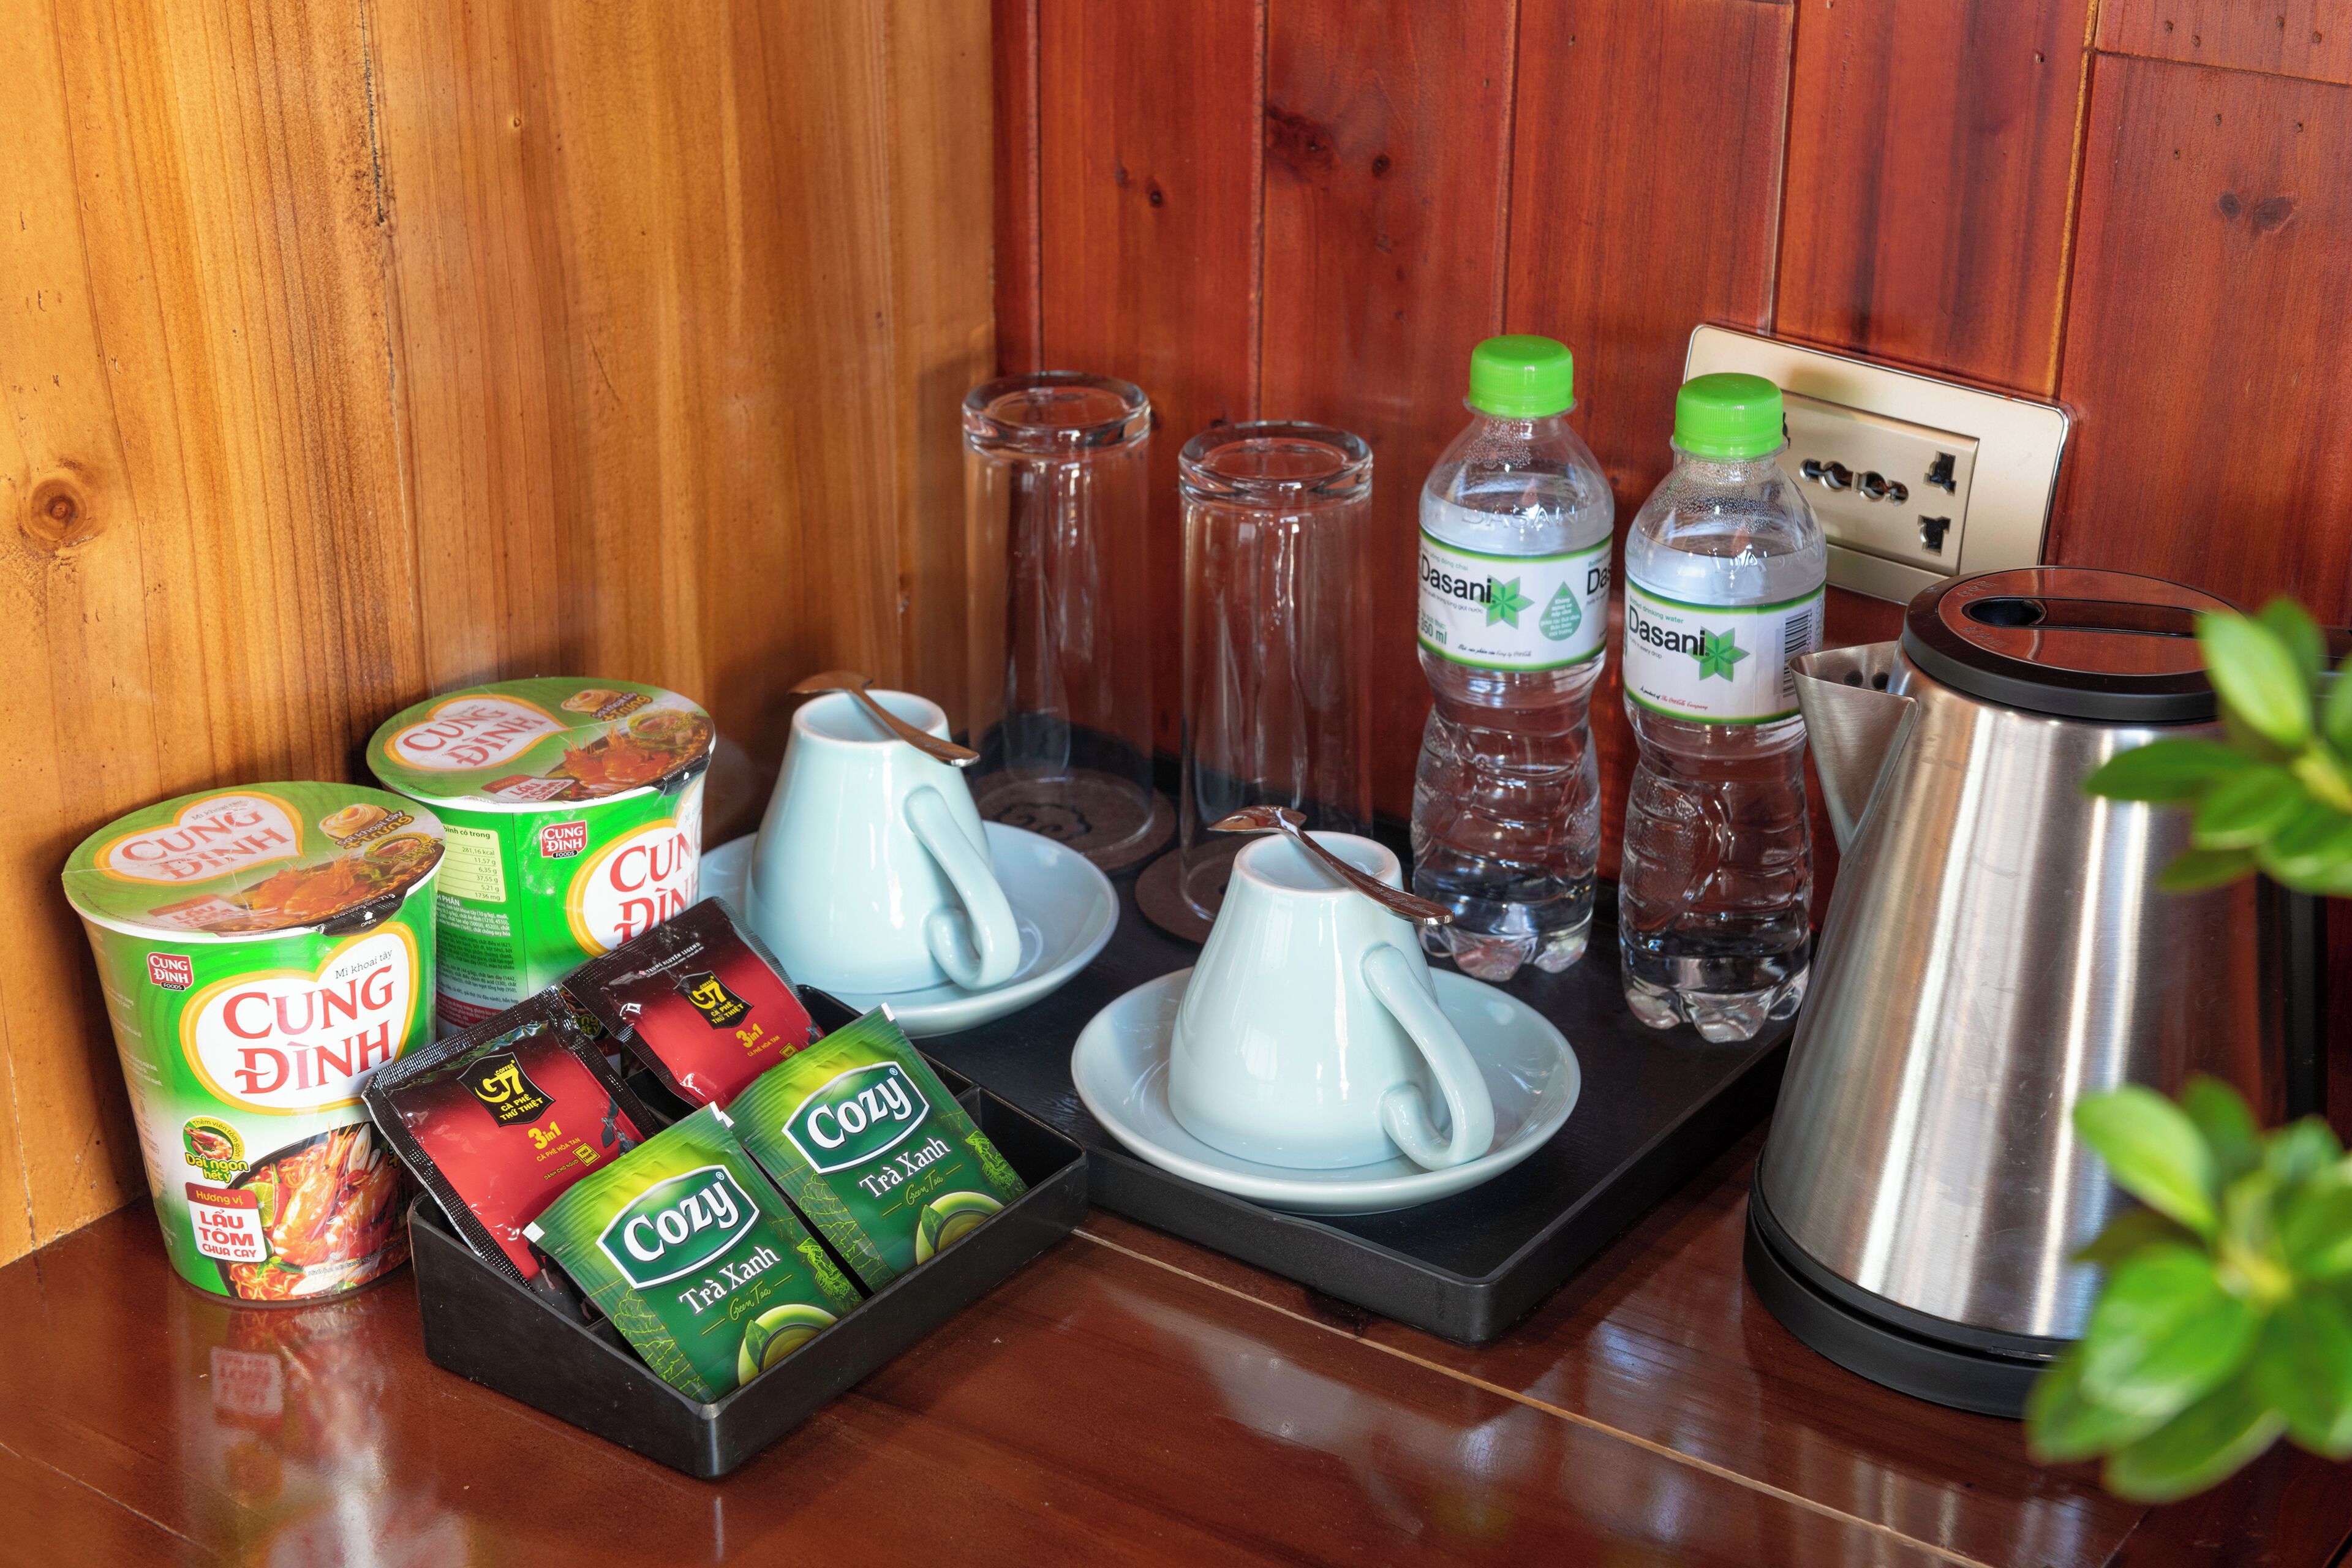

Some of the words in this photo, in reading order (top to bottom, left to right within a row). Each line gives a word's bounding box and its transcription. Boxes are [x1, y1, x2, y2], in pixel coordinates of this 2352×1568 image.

[1422, 553, 1491, 605] Dasani
[1643, 606, 1664, 620] drinking
[1665, 615, 1684, 624] water
[1435, 629, 1447, 644] ml
[1629, 604, 1706, 657] Dasani
[1651, 650, 1662, 659] drop
[1687, 701, 1709, 710] Company
[402, 707, 508, 751] CUNG
[443, 715, 548, 766] ĐÌNH
[205, 804, 228, 818] khoai
[122, 811, 264, 861] CUNG
[355, 821, 385, 839] khoai
[386, 810, 404, 824] tây
[470, 831, 491, 840] trong
[544, 826, 584, 840] CUNG
[149, 827, 292, 880] ĐÌNH
[546, 838, 582, 852] ĐÌNH
[361, 919, 377, 927] OPEN
[149, 955, 189, 971] CUNG
[336, 968, 348, 979] Mì
[351, 956, 377, 974] khoai
[379, 949, 392, 962] tây
[645, 962, 663, 973] TRUNG
[681, 942, 701, 956] LEGEND
[154, 967, 189, 984] ĐÌNH
[222, 964, 394, 1040] CUNG
[688, 981, 727, 1009] G7
[723, 1003, 744, 1018] THIỆT
[736, 1023, 764, 1048] 3in1
[235, 1019, 393, 1095] ĐÌNH
[495, 1063, 515, 1076] COFFEE
[475, 1066, 525, 1103] G7
[499, 1109, 519, 1120] THỨ
[518, 1097, 543, 1113] THIỆT
[500, 1102, 514, 1112] CÀ
[513, 1093, 532, 1106] PHÊ
[807, 1076, 913, 1150] Cozy
[212, 1121, 227, 1132] viên
[227, 1129, 238, 1143] tôm
[234, 1143, 243, 1157] giòn
[527, 1121, 562, 1150] 3in1
[536, 1153, 547, 1162] CÀ
[545, 1147, 559, 1157] PHÊ
[556, 1144, 571, 1152] HÒA
[568, 1137, 581, 1146] TAN
[185, 1152, 209, 1169] Dai
[209, 1160, 248, 1173] ngon
[544, 1170, 557, 1180] DÀNH
[859, 1164, 903, 1199] Trà
[896, 1136, 951, 1177] Xanh
[203, 1168, 224, 1182] hết
[224, 1169, 232, 1183] ý
[905, 1183, 930, 1205] Green
[923, 1170, 944, 1189] Tea
[196, 1190, 231, 1205] Hương
[232, 1195, 244, 1206] vị
[200, 1209, 244, 1229] LẨU
[623, 1180, 739, 1262] Cozy
[198, 1226, 255, 1247] TÔM
[202, 1243, 231, 1256] CHUA
[233, 1249, 257, 1258] CAY
[678, 1279, 728, 1316] Trà
[718, 1245, 782, 1292] Xanh
[729, 1297, 755, 1321] Green
[745, 1280, 771, 1305] Tea
